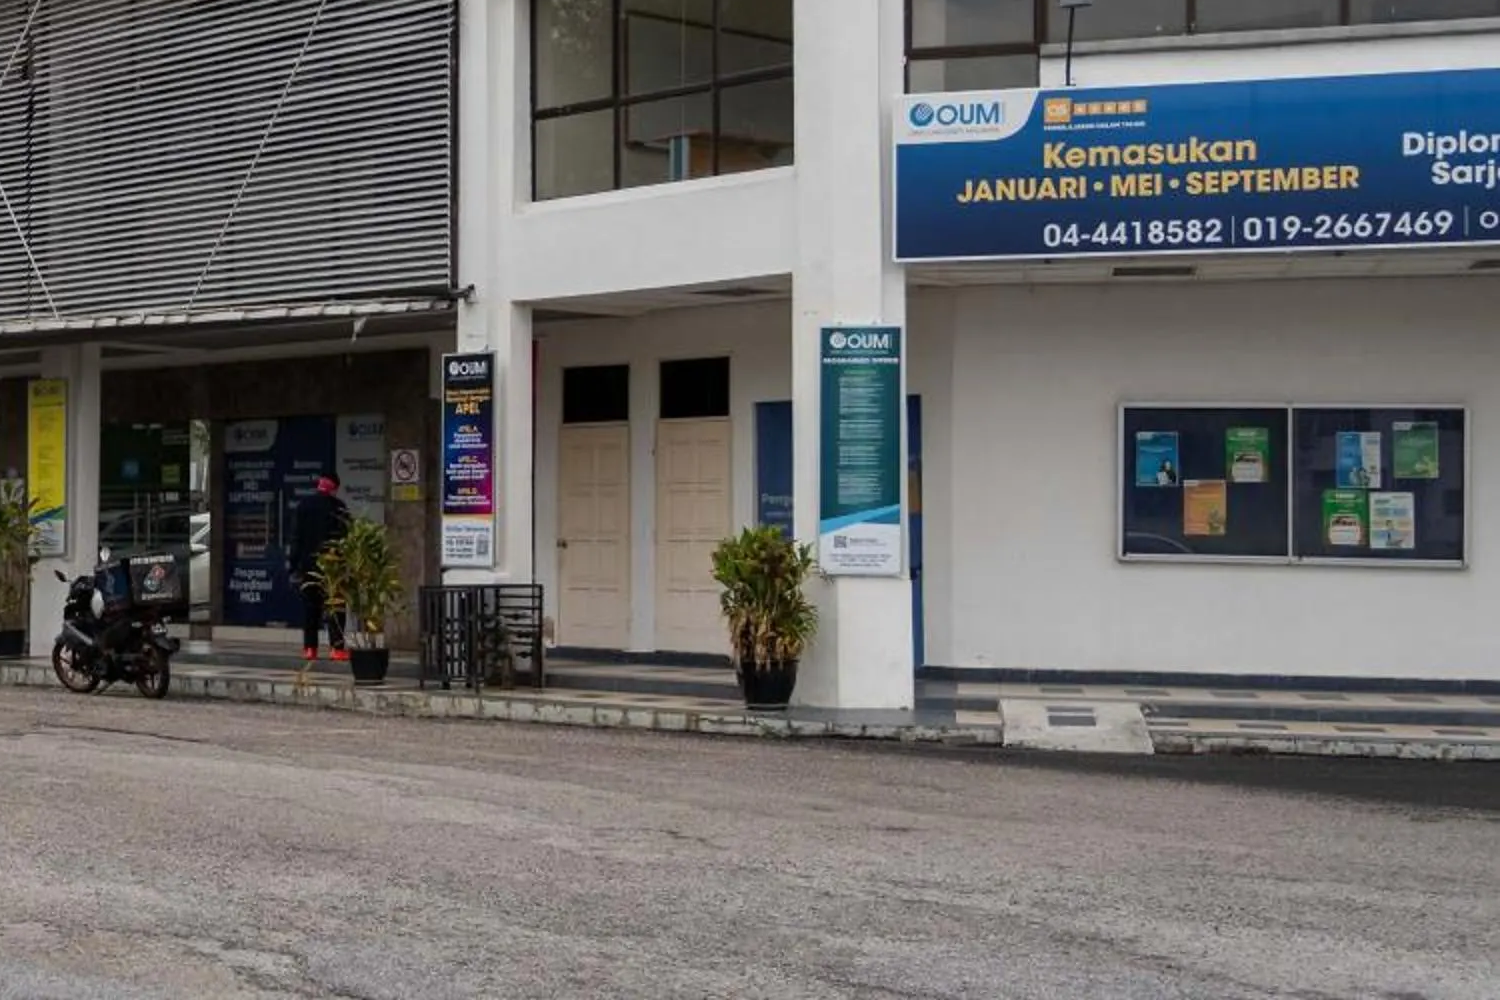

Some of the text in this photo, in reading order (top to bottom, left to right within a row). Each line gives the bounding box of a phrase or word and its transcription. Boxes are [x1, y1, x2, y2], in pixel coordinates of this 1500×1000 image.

[936, 101, 1001, 126] OUM
[1043, 136, 1257, 169] Kemasukan
[956, 164, 1360, 204] JANUARI MEI SEPTEMBER
[1431, 159, 1500, 189] Sarj
[1043, 218, 1223, 247] 04-4418582
[1243, 209, 1454, 243] 019-2667469
[847, 333, 889, 349] OUM
